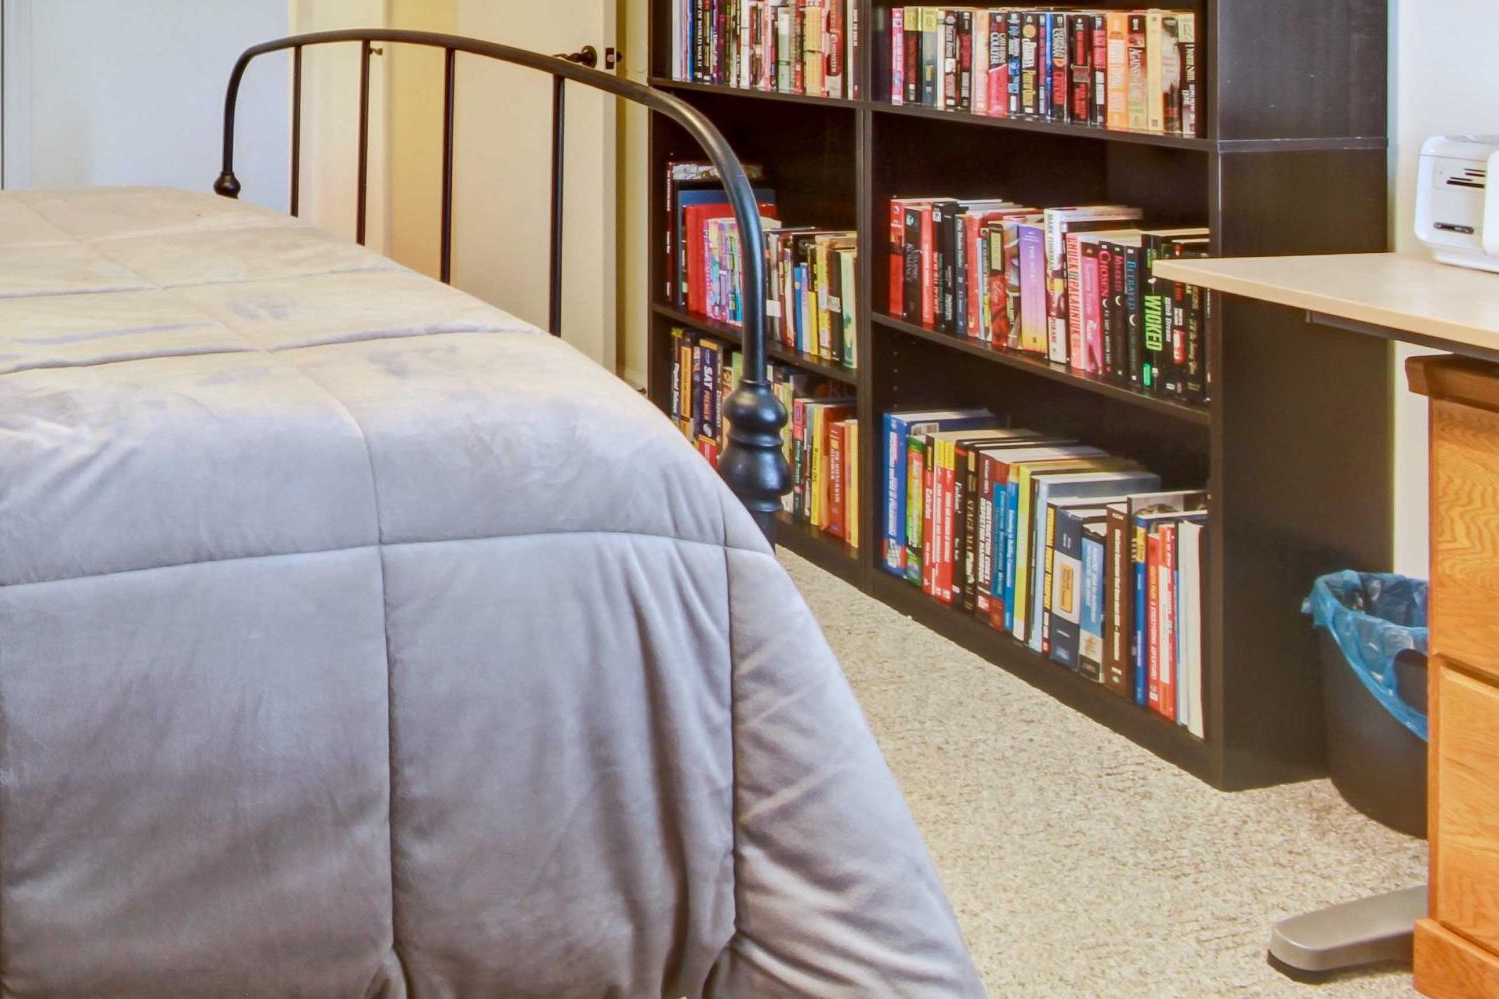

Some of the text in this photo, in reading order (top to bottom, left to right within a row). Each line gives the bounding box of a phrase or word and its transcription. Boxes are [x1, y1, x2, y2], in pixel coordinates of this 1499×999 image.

[1067, 237, 1081, 336] CHUCK PALAHNIUK
[1099, 250, 1111, 298] CHOSEN
[1126, 259, 1137, 310] BETRAYED
[1144, 295, 1162, 351] WICKED
[703, 364, 713, 421] SAT PREMIER
[925, 487, 933, 519] Calculus
